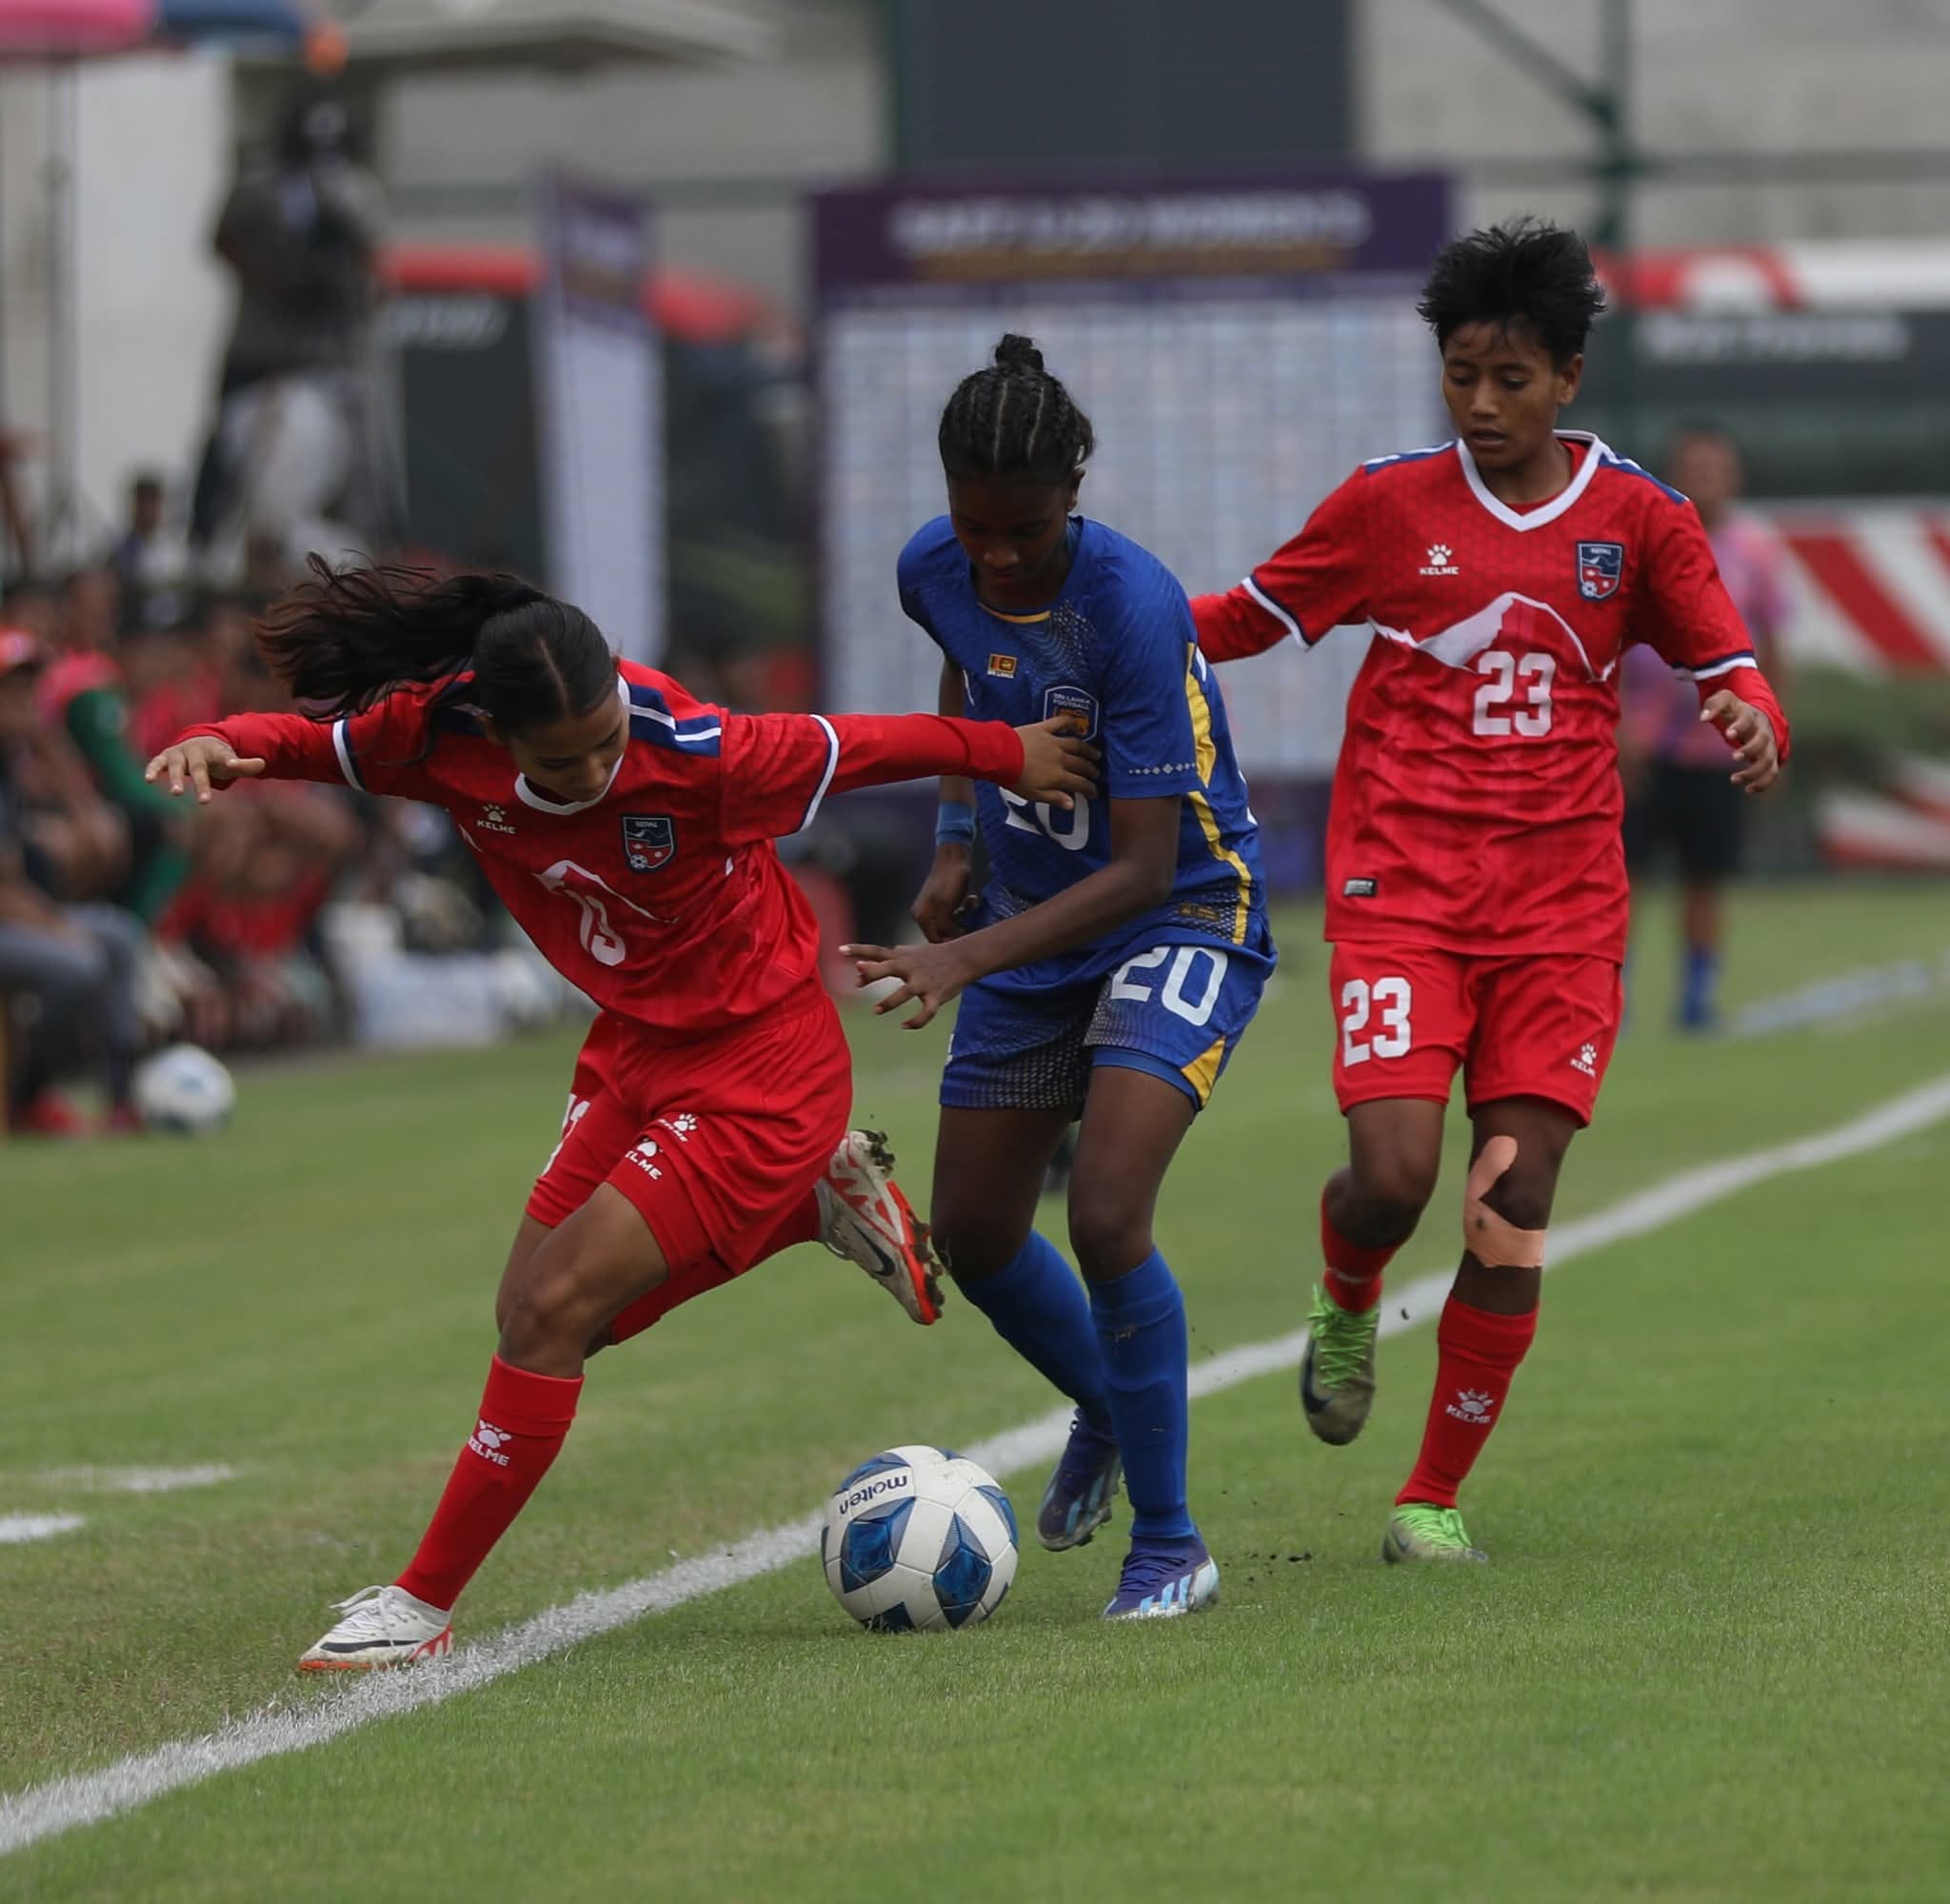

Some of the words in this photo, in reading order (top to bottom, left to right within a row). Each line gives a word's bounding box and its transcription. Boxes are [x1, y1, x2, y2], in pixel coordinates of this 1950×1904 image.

[1419, 565, 1461, 576] KELME
[1473, 650, 1556, 737] 23
[477, 820, 516, 835] KELME
[1111, 945, 1228, 1026] 20
[1343, 977, 1411, 1067] 23
[1446, 1404, 1492, 1424] KELME
[839, 1475, 907, 1515] molten
